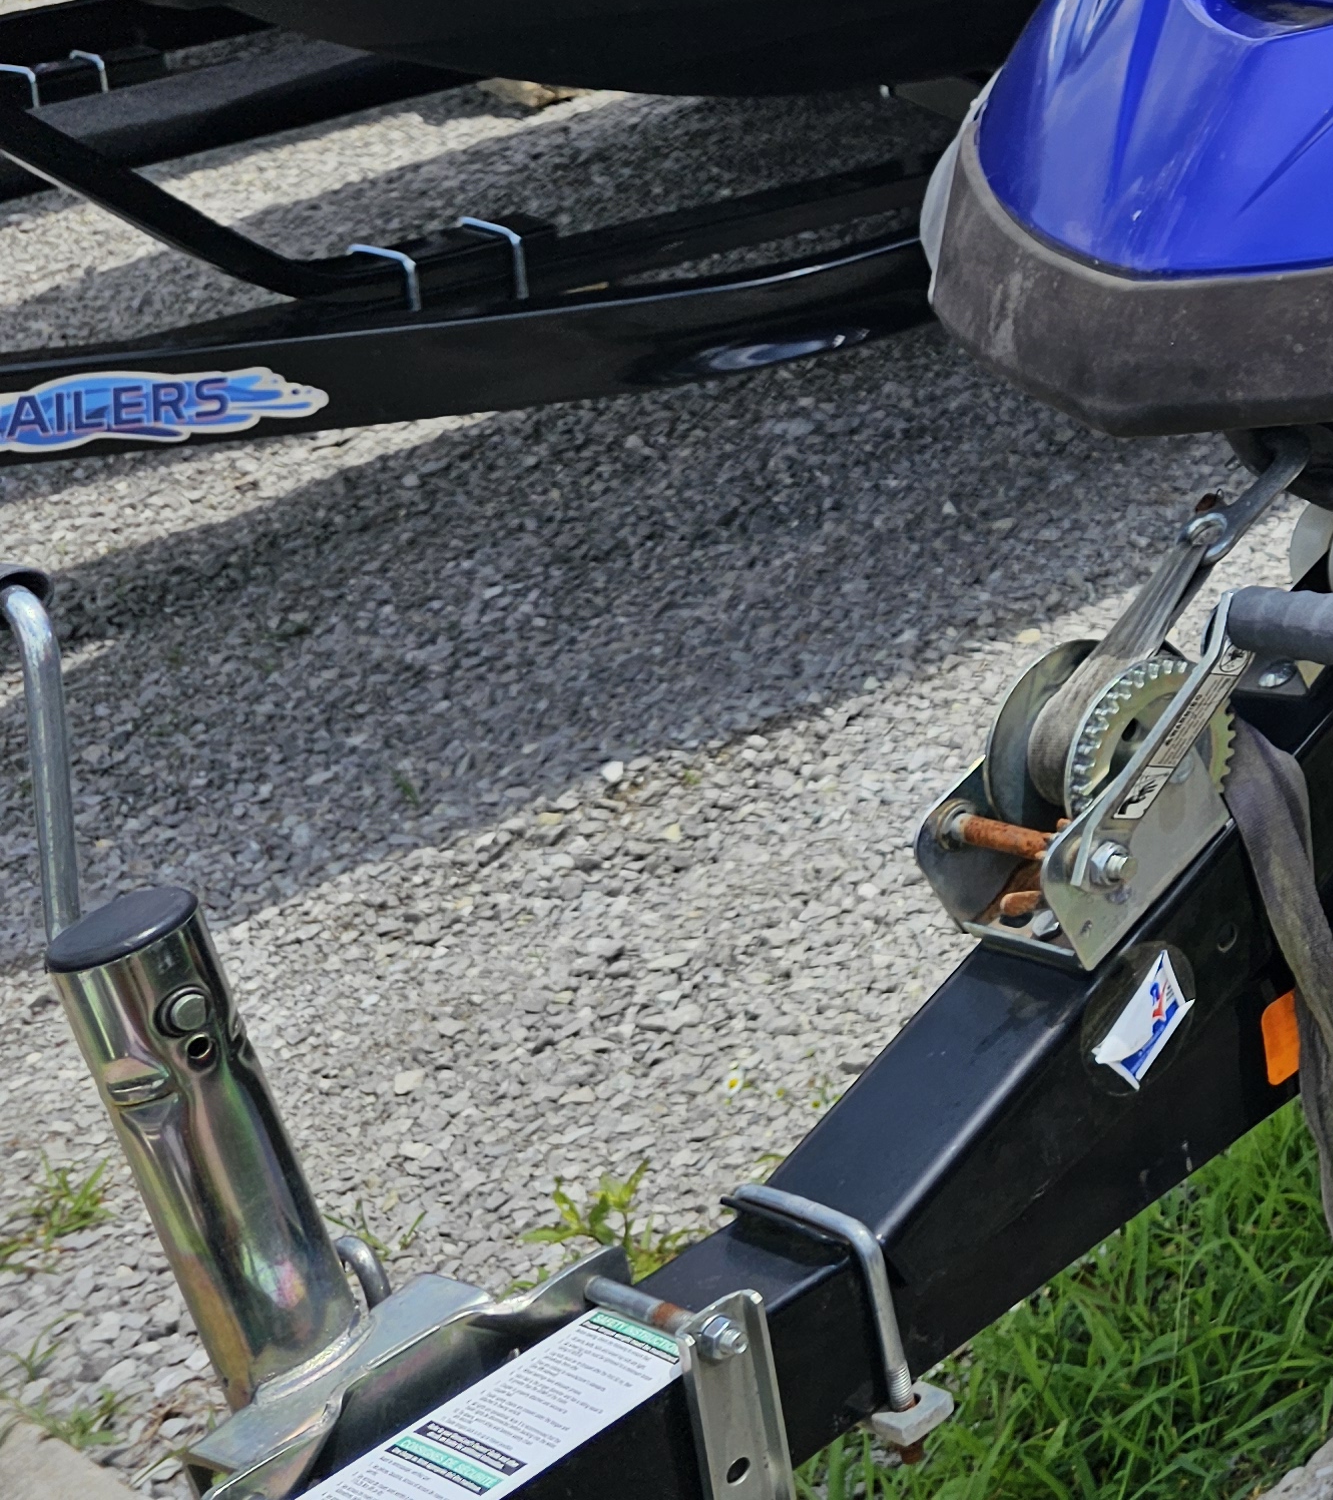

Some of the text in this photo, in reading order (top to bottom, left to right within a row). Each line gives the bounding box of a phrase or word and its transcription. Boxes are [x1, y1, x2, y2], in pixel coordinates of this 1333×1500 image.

[4, 376, 230, 440] AILERS
[594, 1312, 627, 1331] SAFETY
[625, 1323, 680, 1357] INSTRUCTION
